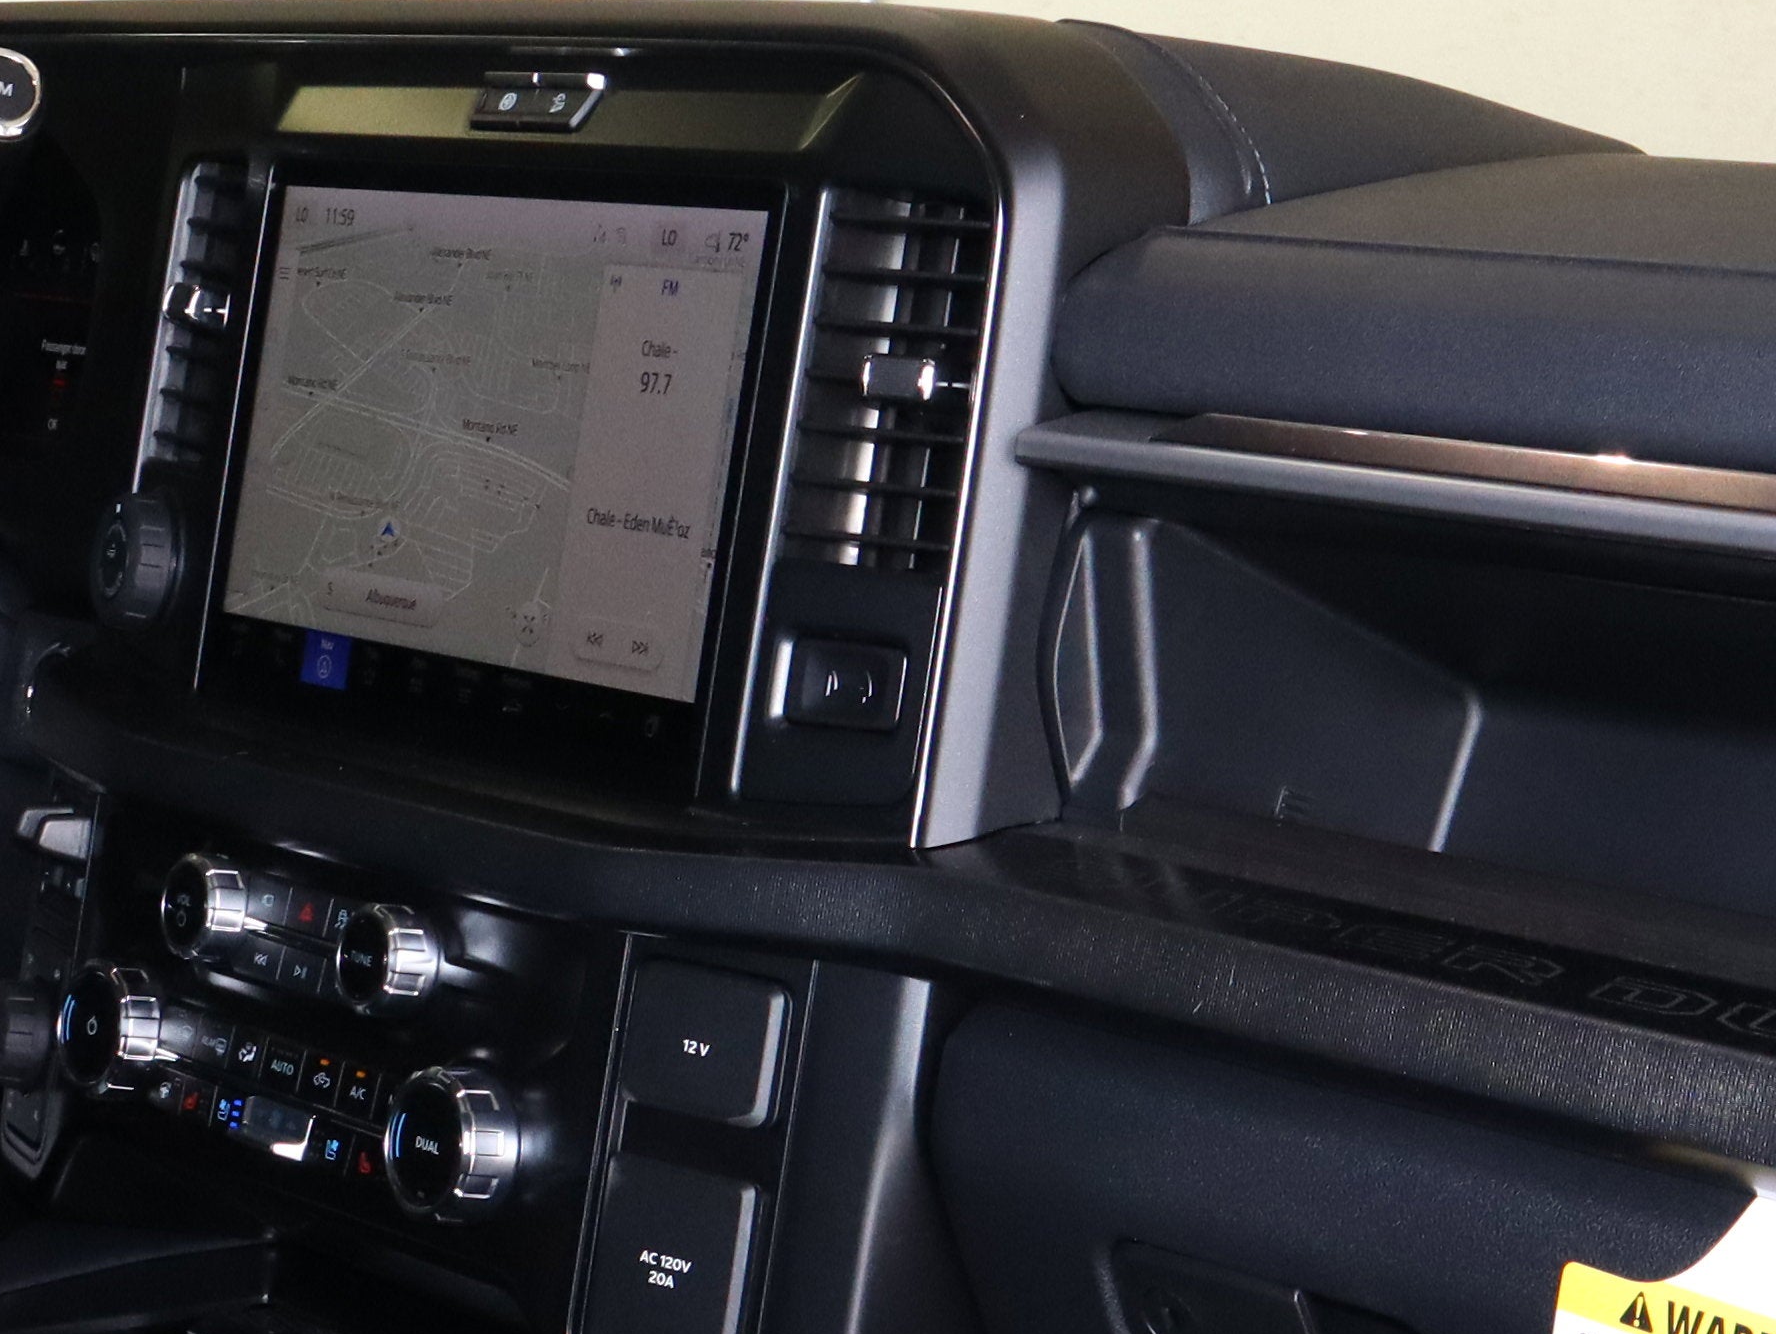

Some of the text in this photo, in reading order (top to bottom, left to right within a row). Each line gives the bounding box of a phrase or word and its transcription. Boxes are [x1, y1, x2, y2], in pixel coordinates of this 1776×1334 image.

[661, 229, 678, 247] LO
[660, 278, 680, 296] FM
[640, 371, 672, 395] 97.7
[682, 1038, 711, 1058] 12 V
[270, 1058, 295, 1077] AUTO
[349, 1084, 367, 1102] A/C
[414, 1134, 441, 1156] DUAL
[638, 1249, 693, 1275] AC 120V
[647, 1269, 675, 1289] 20A
